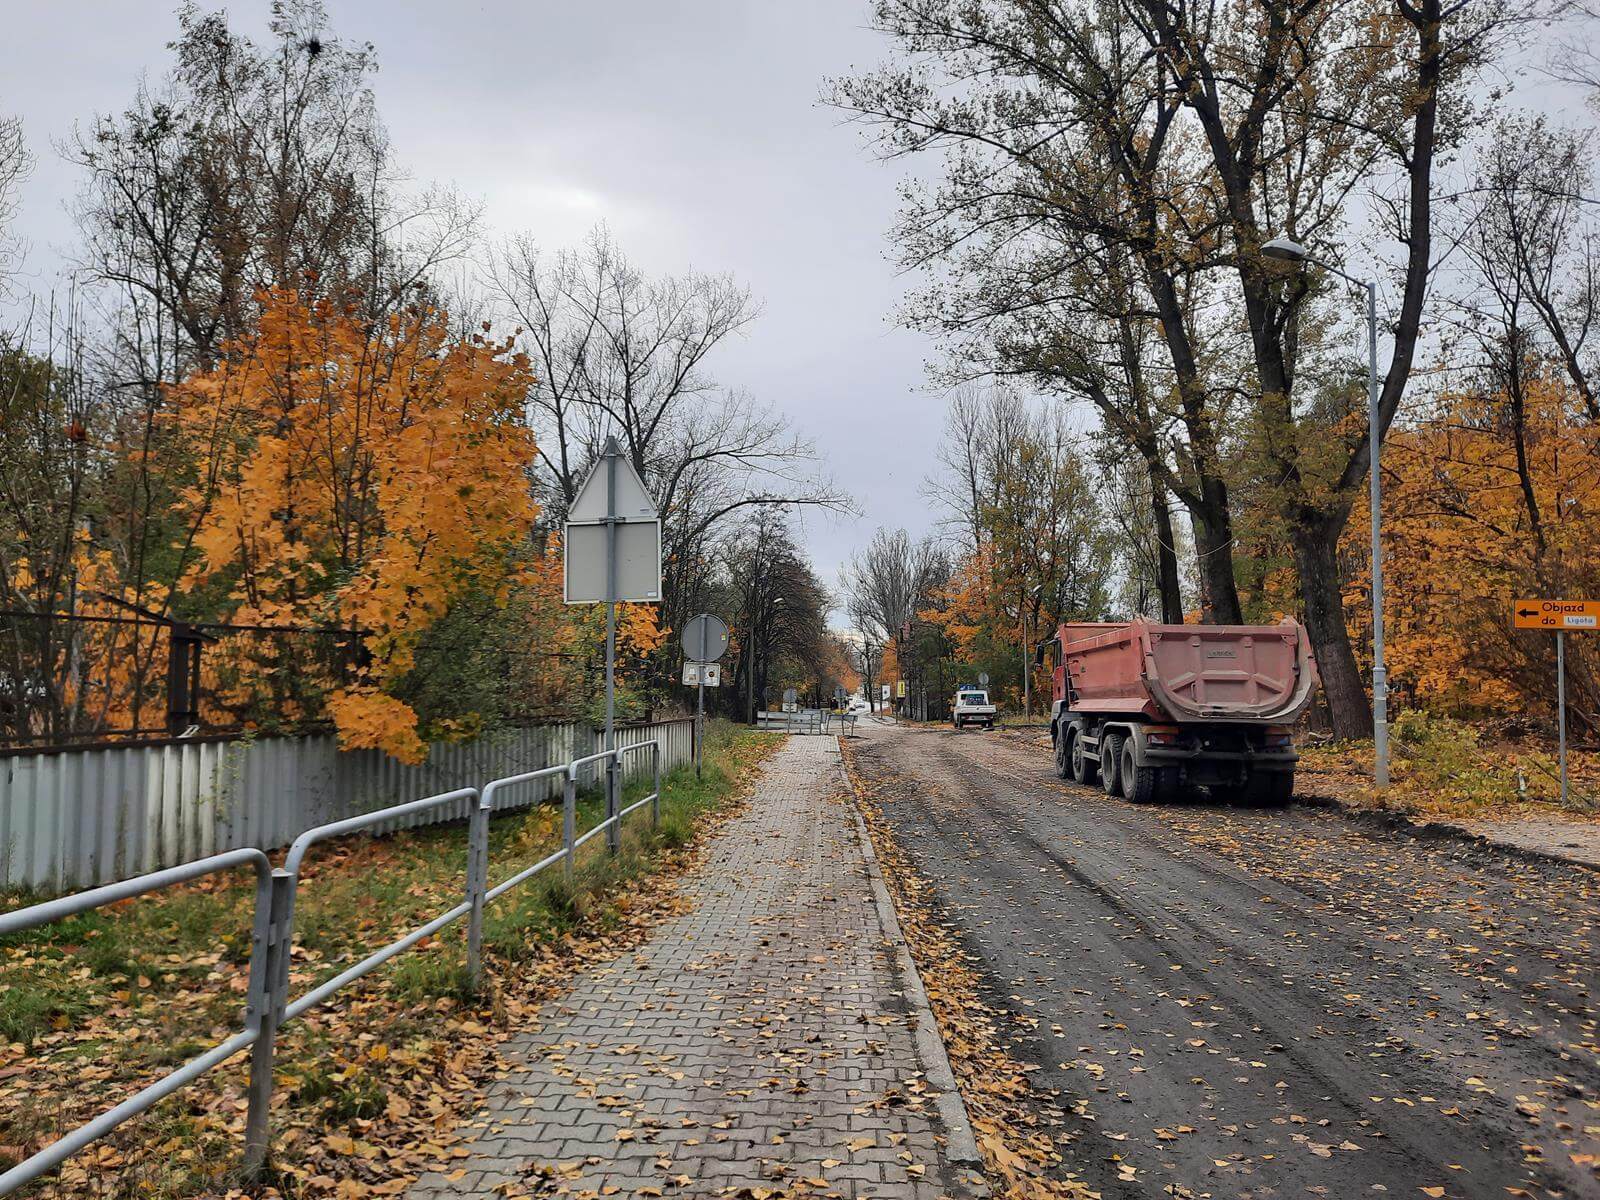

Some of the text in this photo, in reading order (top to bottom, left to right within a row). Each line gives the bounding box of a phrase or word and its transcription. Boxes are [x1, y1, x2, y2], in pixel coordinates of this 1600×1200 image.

[1541, 602, 1585, 613] Objazd
[1541, 616, 1593, 625] do Ligota
